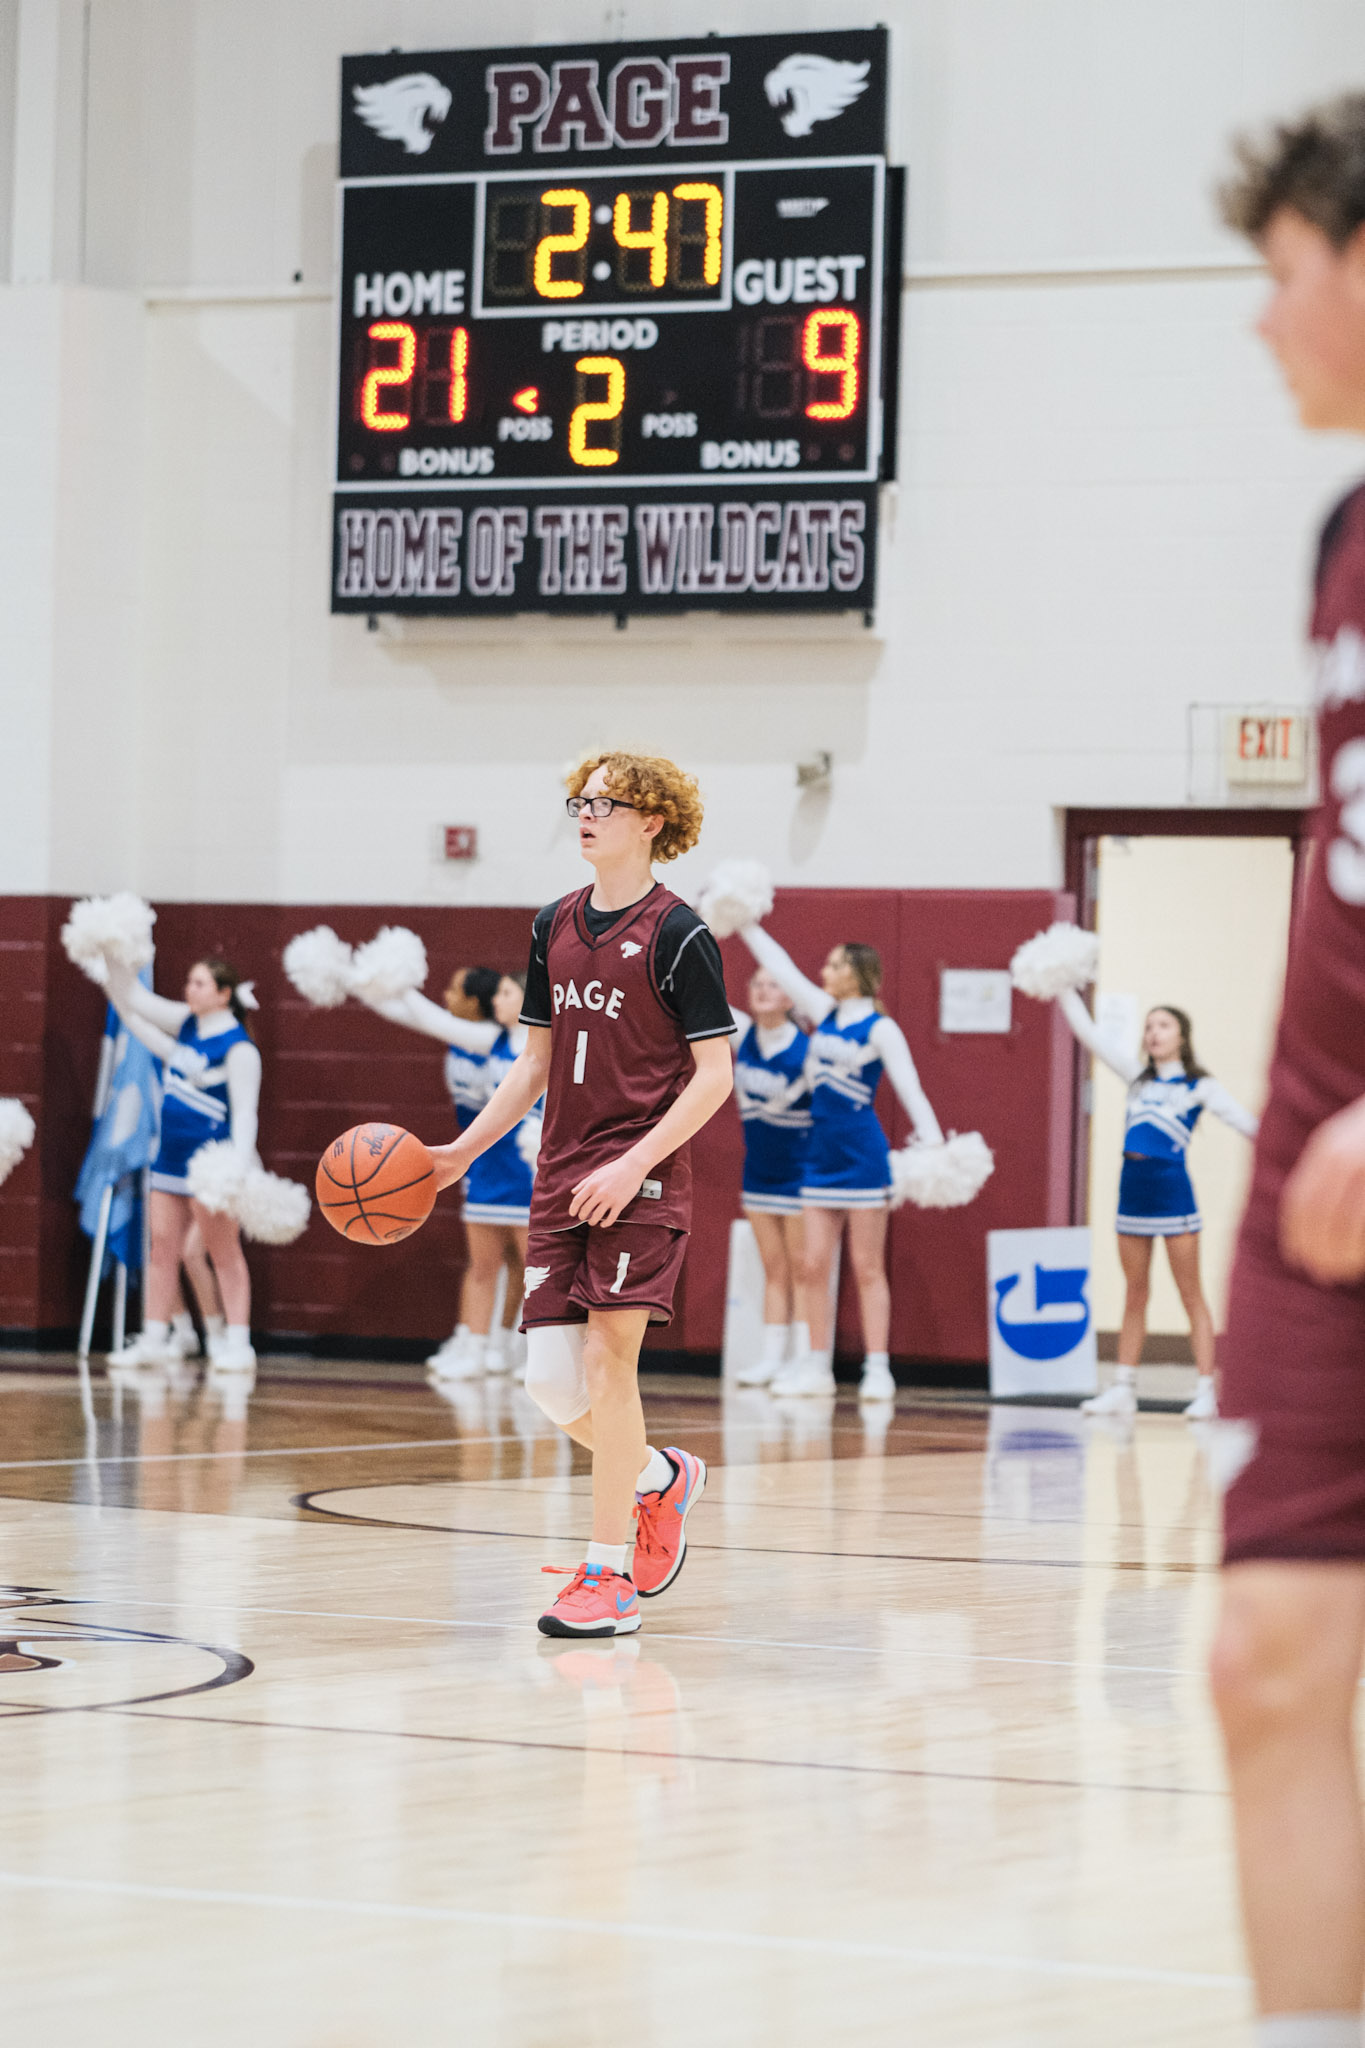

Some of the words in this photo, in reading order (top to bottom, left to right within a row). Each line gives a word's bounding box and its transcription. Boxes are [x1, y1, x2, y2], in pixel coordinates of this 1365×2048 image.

[484, 53, 731, 155] PAGE
[533, 182, 724, 299] 2:47
[354, 269, 466, 318] HOME
[734, 255, 866, 305] GUEST
[541, 317, 659, 353] PERIOD
[360, 321, 470, 432] 21
[802, 307, 862, 421] 9
[499, 415, 554, 442] POSS
[568, 356, 627, 467] 2
[642, 412, 699, 438] POSS
[400, 446, 496, 476] BONUS
[700, 441, 801, 469] BONUS
[338, 508, 463, 598] HOME
[468, 506, 528, 597] OF
[535, 504, 629, 596] THE
[635, 499, 866, 594] WILDCATS
[1238, 717, 1292, 759] EXIT
[553, 979, 625, 1020] PAGE
[573, 1030, 588, 1084] 1
[610, 1252, 631, 1293] 1
[995, 1263, 1090, 1360] G
